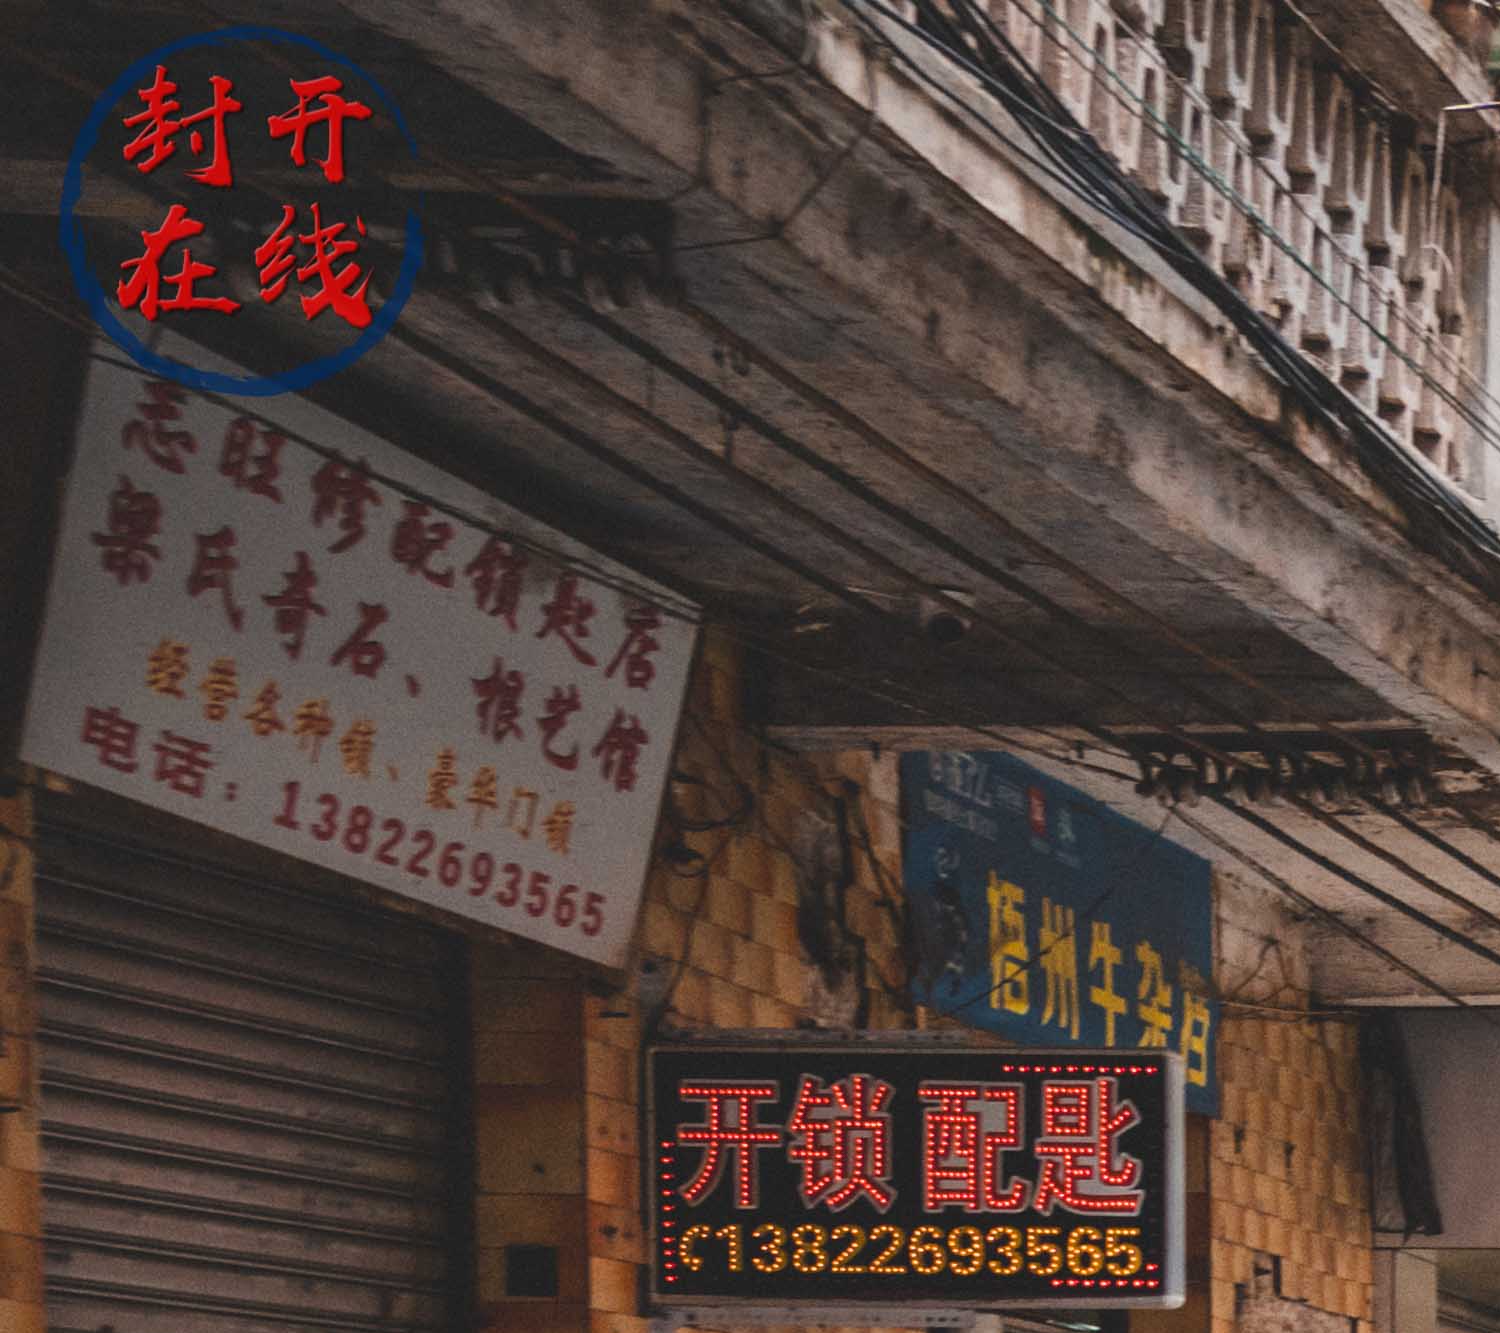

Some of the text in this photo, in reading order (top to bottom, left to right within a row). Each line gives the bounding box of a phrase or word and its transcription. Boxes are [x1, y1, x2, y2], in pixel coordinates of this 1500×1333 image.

[676, 1072, 1143, 1216] 开锁配匙
[712, 1222, 1142, 1277] 13822693565
